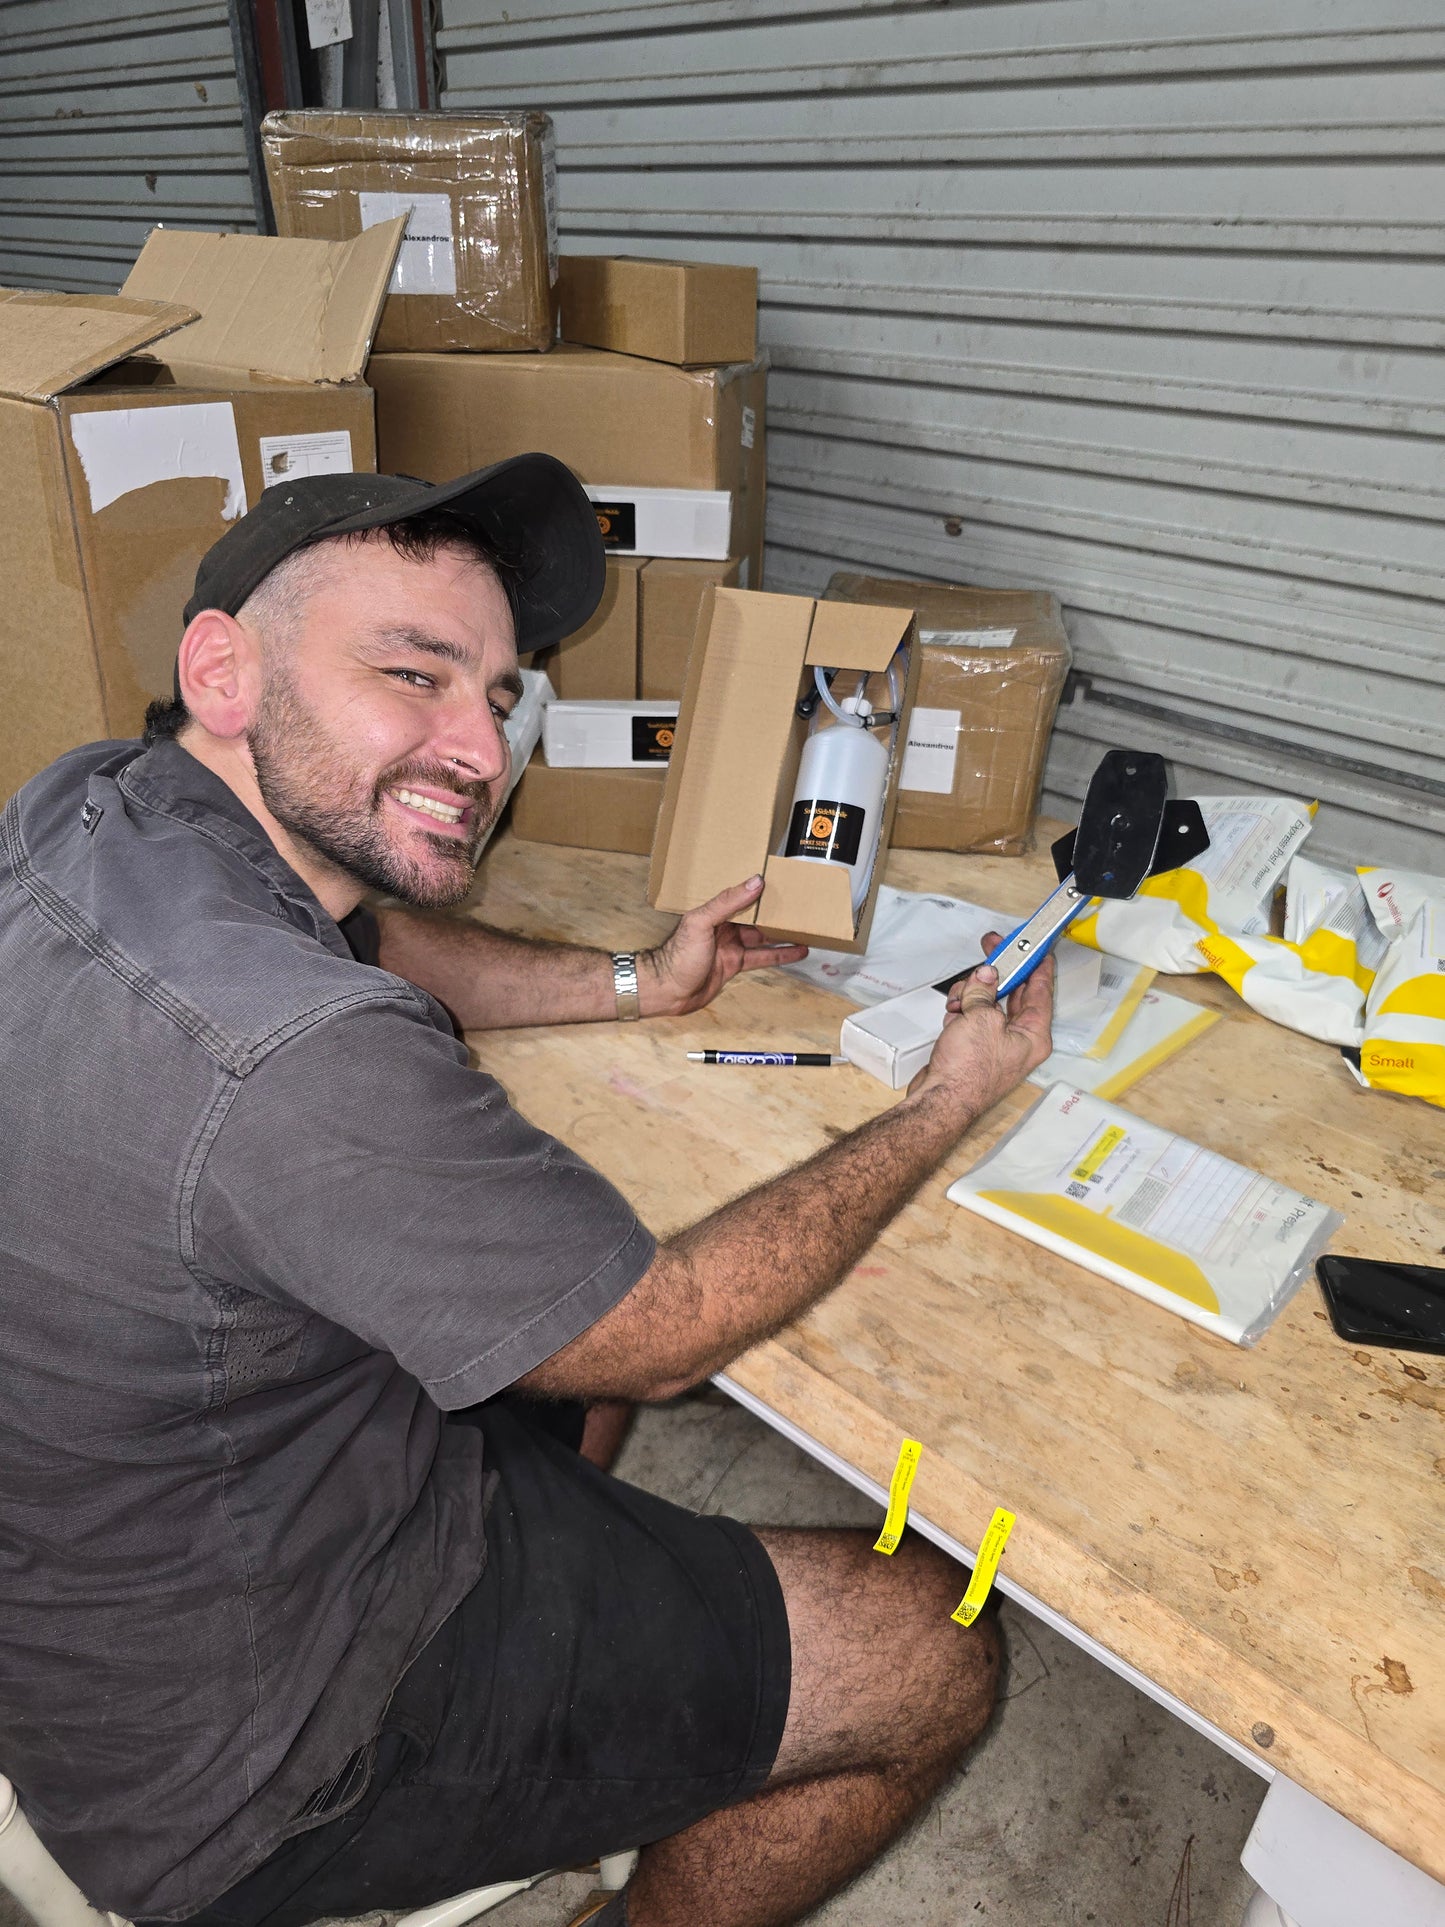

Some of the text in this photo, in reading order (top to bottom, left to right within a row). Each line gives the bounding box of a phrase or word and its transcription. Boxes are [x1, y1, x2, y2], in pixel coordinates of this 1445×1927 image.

[403, 234, 450, 242] Alexandrou
[907, 740, 955, 750] Alexandrou
[1280, 819, 1305, 849] Express
[1267, 847, 1285, 867] Post
[1196, 939, 1225, 969] Small
[1369, 1053, 1415, 1069] Small
[1059, 1095, 1080, 1115] Post
